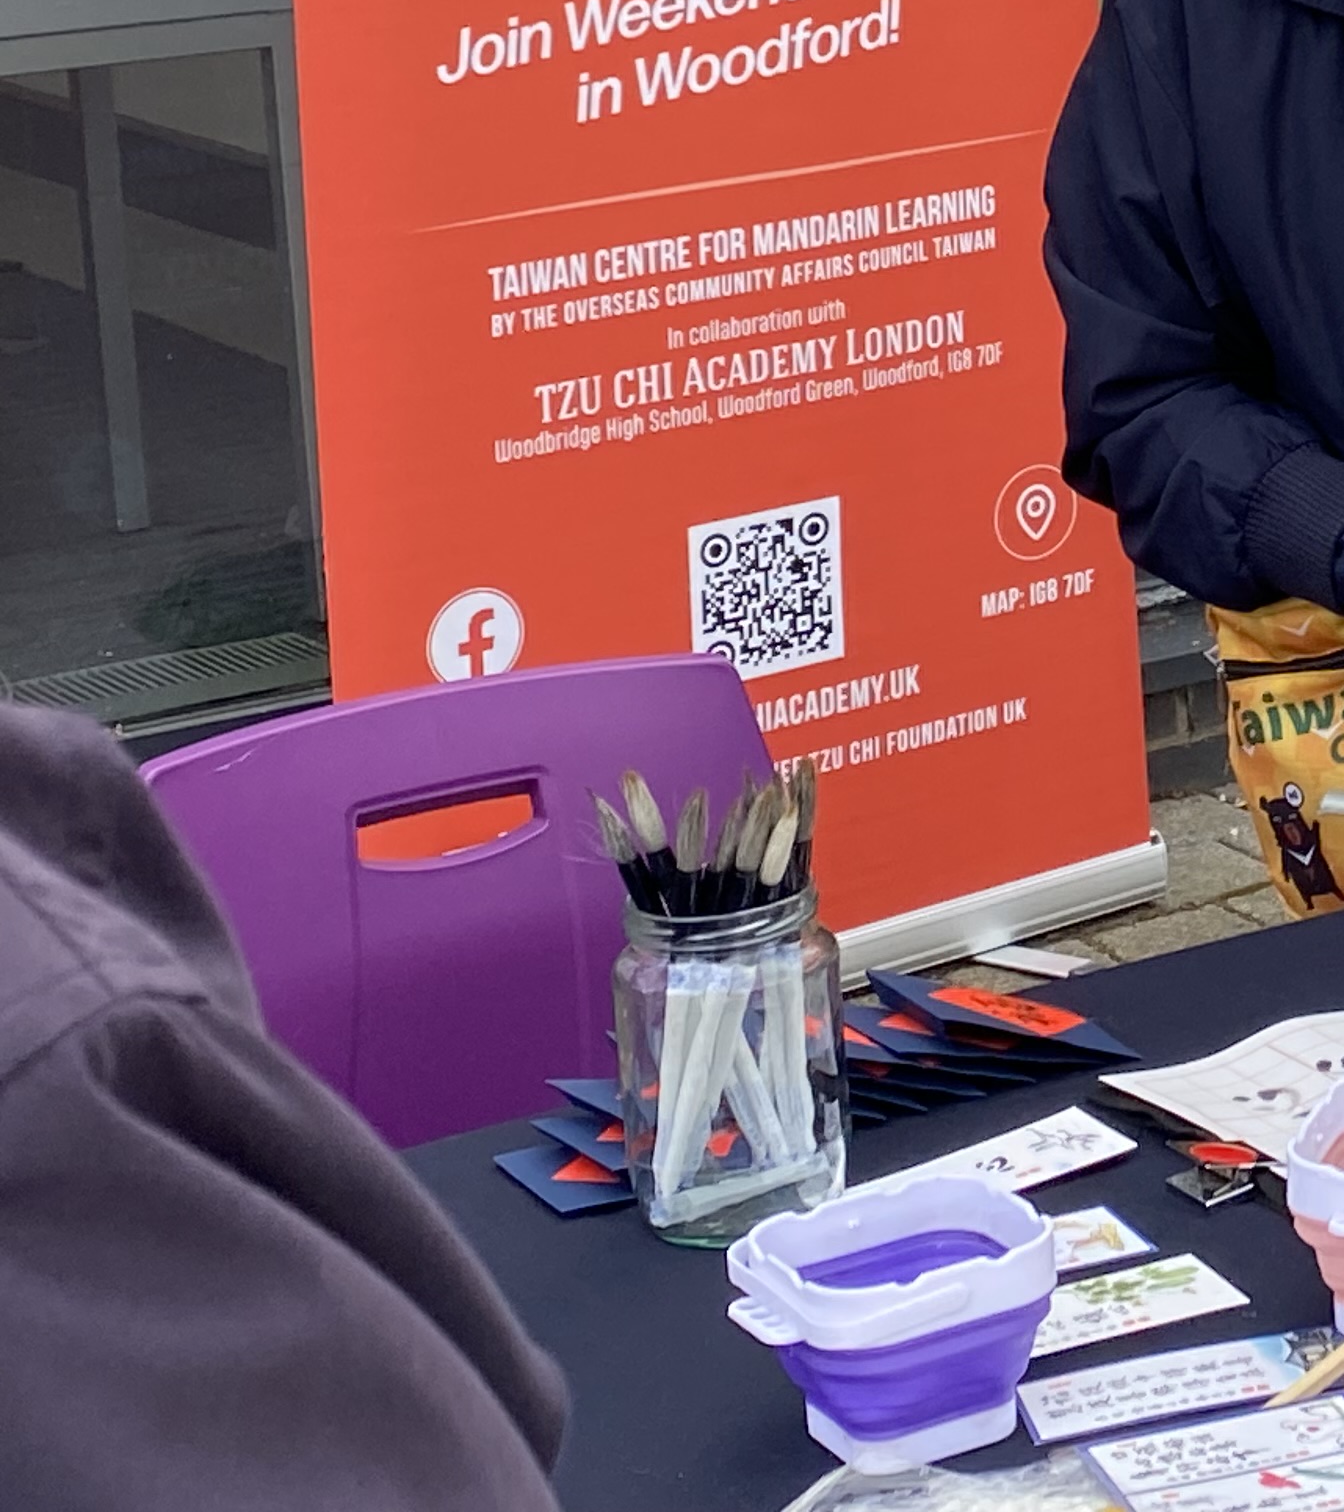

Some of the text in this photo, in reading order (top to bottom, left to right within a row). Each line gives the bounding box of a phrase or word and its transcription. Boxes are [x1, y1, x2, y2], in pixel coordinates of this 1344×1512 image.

[436, 16, 551, 84] Join
[577, 69, 620, 123] in
[489, 187, 996, 302] TAIWAN CENTRE FOR MANDARIN LEARNING
[491, 229, 996, 338] BY THE OVERSEAS COMMUNITY AFFAIRS COUNCIL TAIWAN
[667, 299, 846, 349] In collaboration with
[534, 310, 965, 423] TZU CHI ACADEMY LONDON
[494, 342, 1003, 464] Woodbridge High School, Woodford Green, Woodford, IG8 7DF
[981, 568, 1094, 618] MAP: IG8 7DF
[849, 736, 880, 765] CHI
[887, 705, 998, 756] FOUNDATION
[1003, 697, 1027, 724] UK
